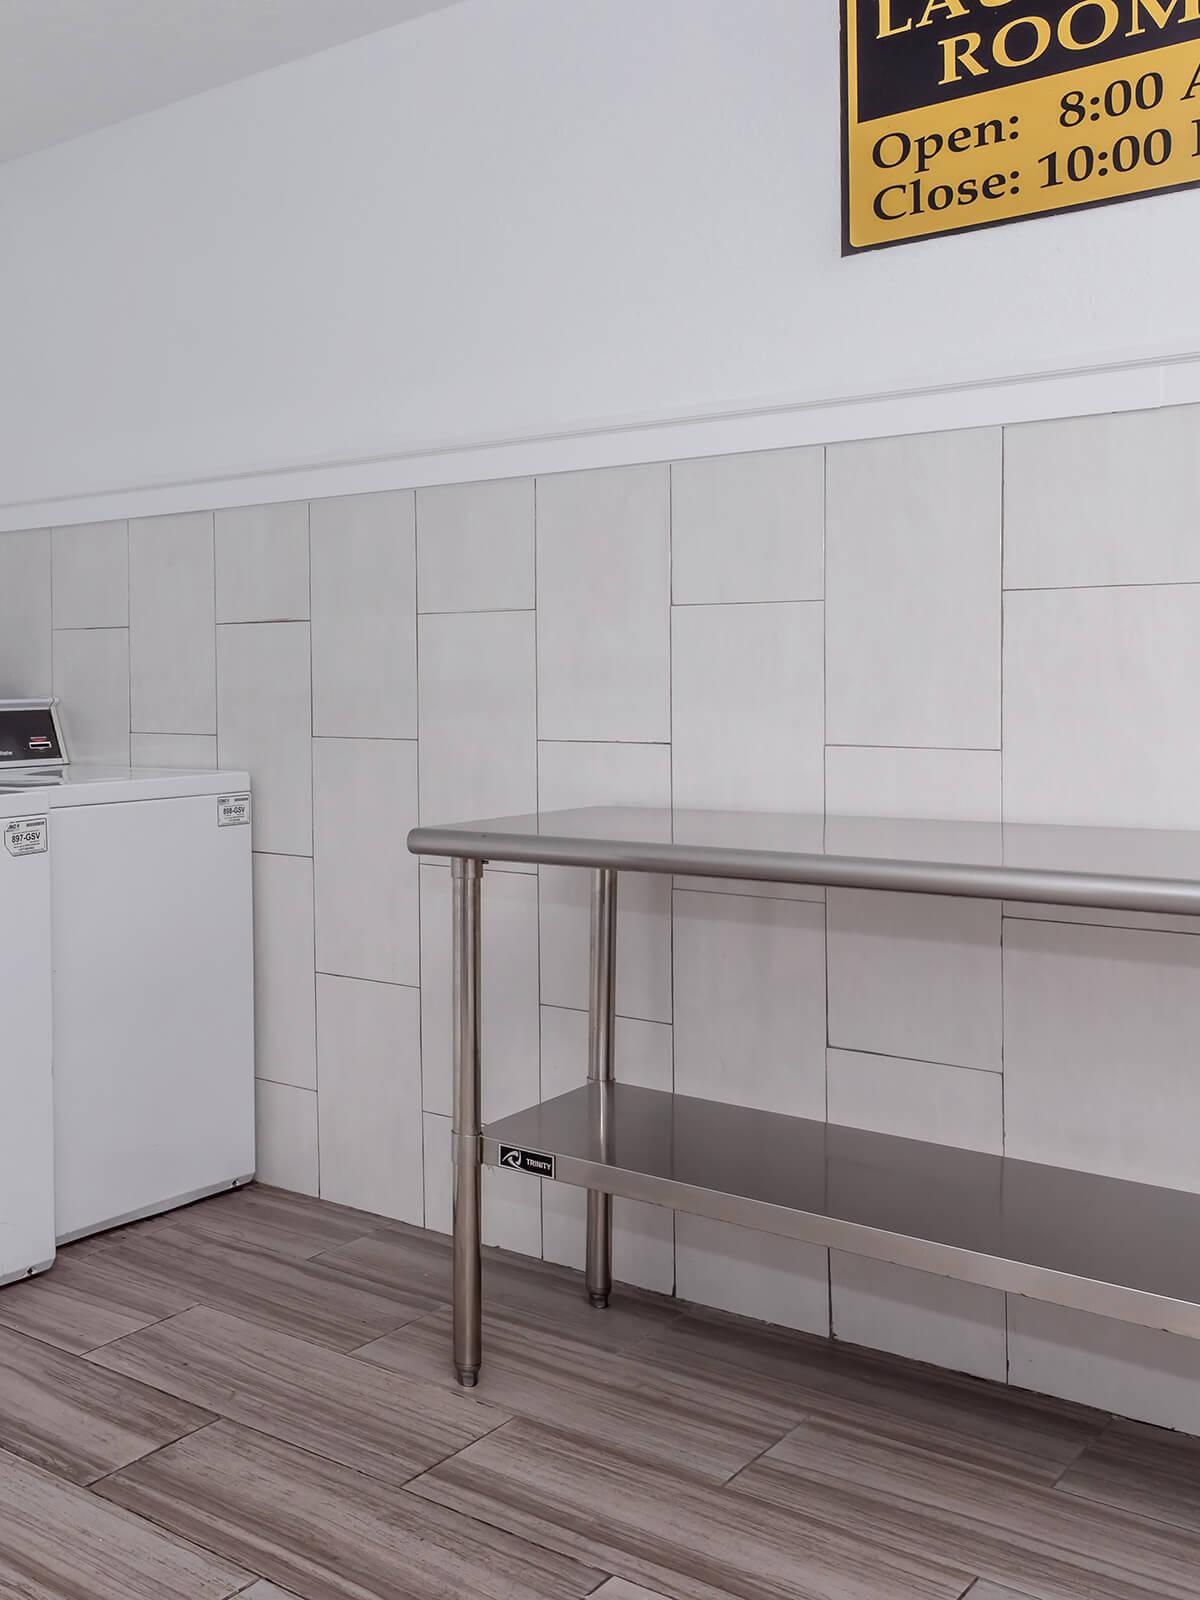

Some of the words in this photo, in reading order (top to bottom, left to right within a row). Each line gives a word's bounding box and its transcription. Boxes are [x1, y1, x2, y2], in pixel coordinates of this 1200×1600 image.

[876, 0, 1013, 39] LA
[937, 0, 1200, 85] ROOM
[872, 115, 1019, 174] Open:
[1059, 71, 1164, 128] 8:00
[873, 170, 1020, 221] Close:
[1038, 128, 1173, 189] 10:00
[526, 1158, 551, 1170] TRINITY
